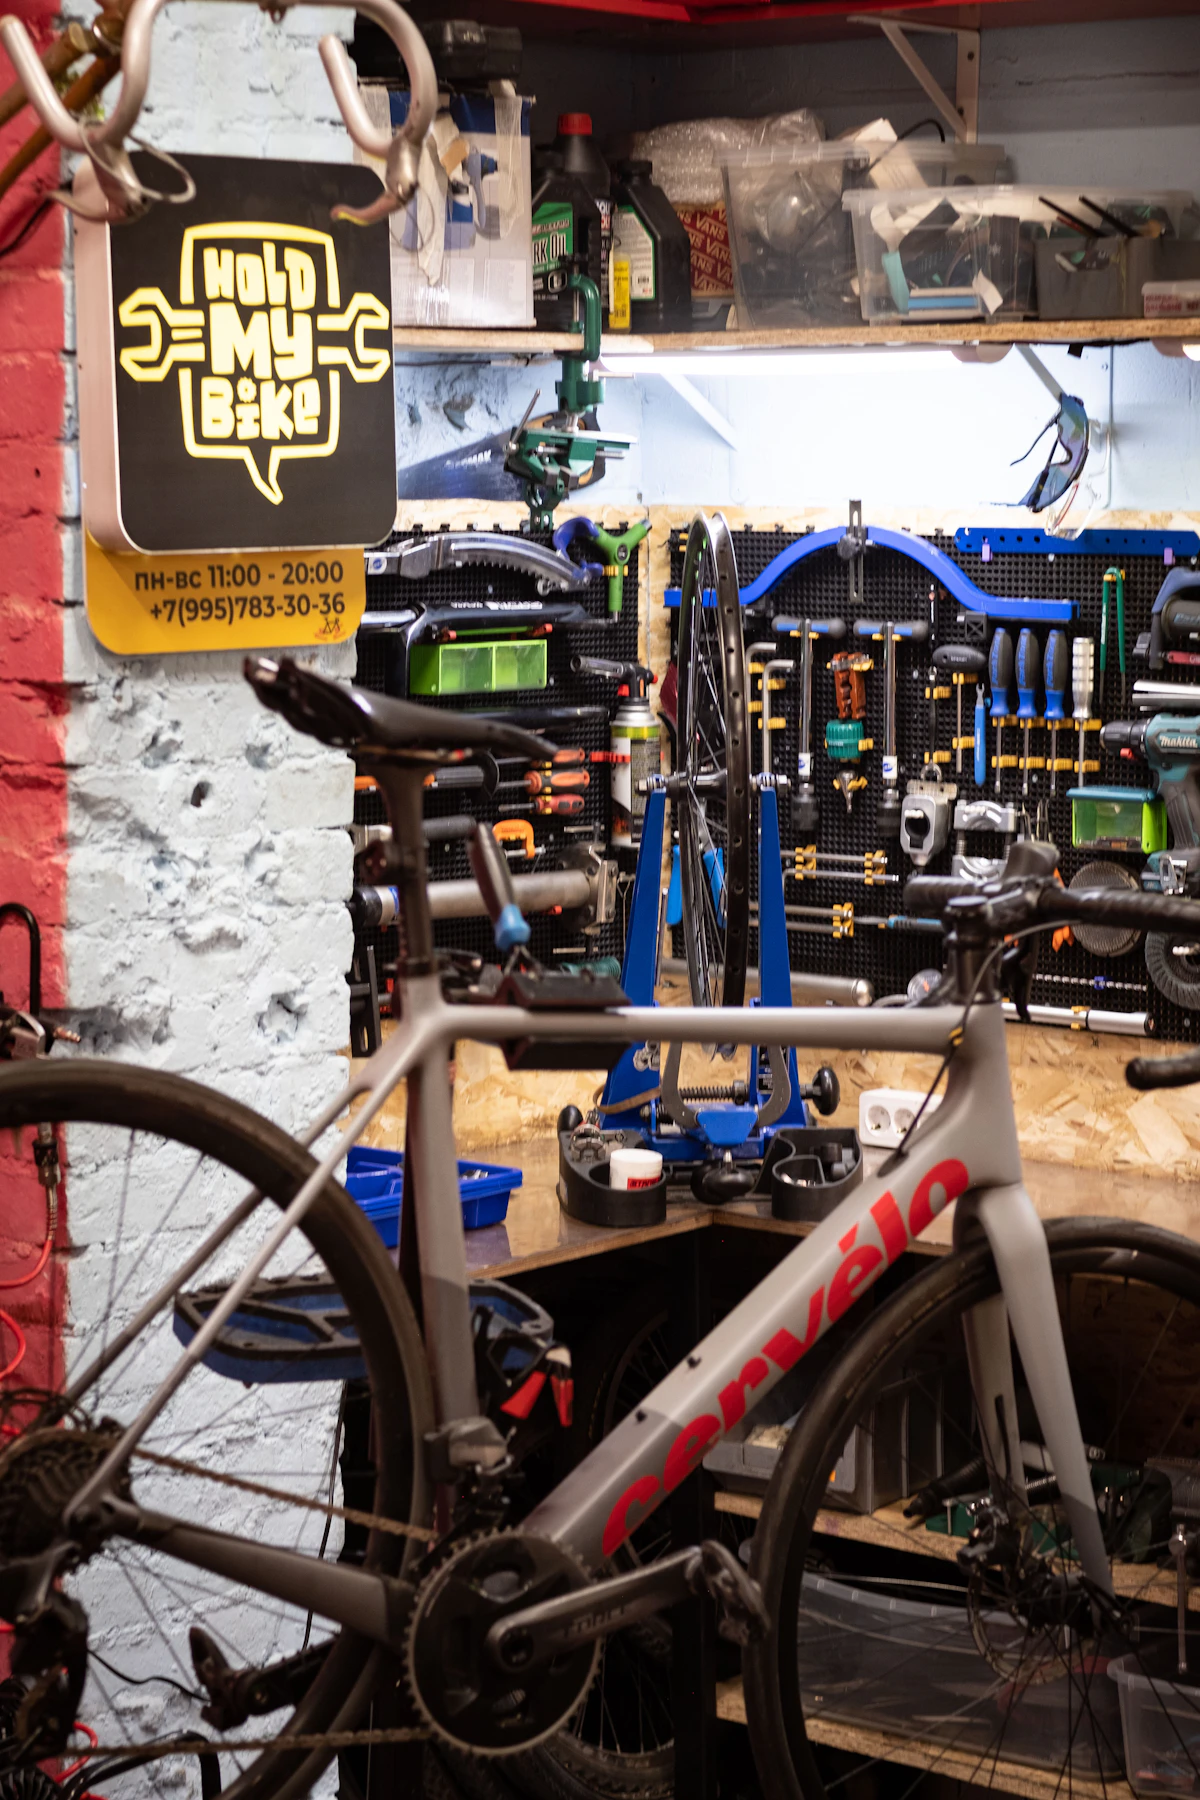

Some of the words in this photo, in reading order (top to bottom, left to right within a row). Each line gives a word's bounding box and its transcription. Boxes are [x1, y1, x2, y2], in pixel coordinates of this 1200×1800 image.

[696, 212, 728, 241] VANS
[532, 238, 549, 266] RK
[691, 249, 715, 275] ANS
[706, 236, 732, 266] VAN
[207, 563, 262, 588] 11:00
[281, 560, 344, 586] 20:00
[150, 591, 347, 628] +7(995)783-30-36
